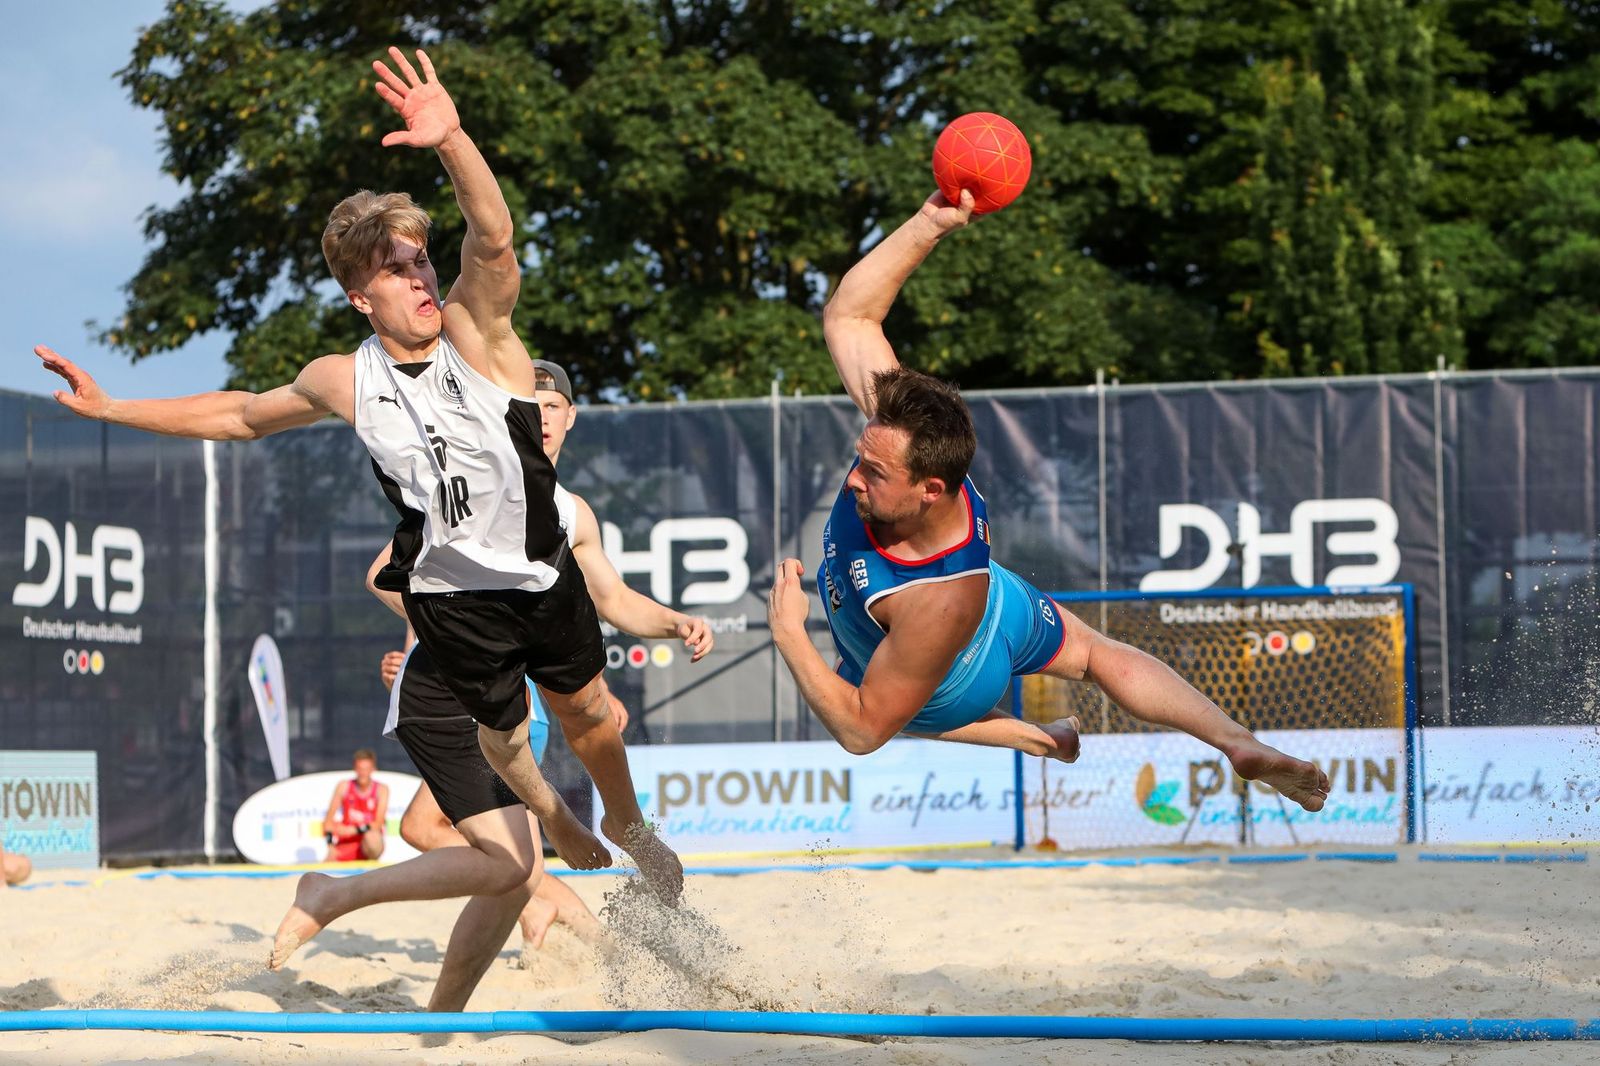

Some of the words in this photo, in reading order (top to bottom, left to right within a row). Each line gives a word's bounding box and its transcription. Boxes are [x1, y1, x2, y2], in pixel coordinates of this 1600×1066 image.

[12, 516, 144, 614] DHB
[602, 517, 750, 605] HB
[1139, 498, 1400, 592] DHB
[854, 558, 869, 590] GER
[23, 616, 74, 641] Deutscher
[76, 620, 142, 645] Handballbund
[1261, 599, 1399, 621] Handballbund
[870, 771, 988, 828] einfach
